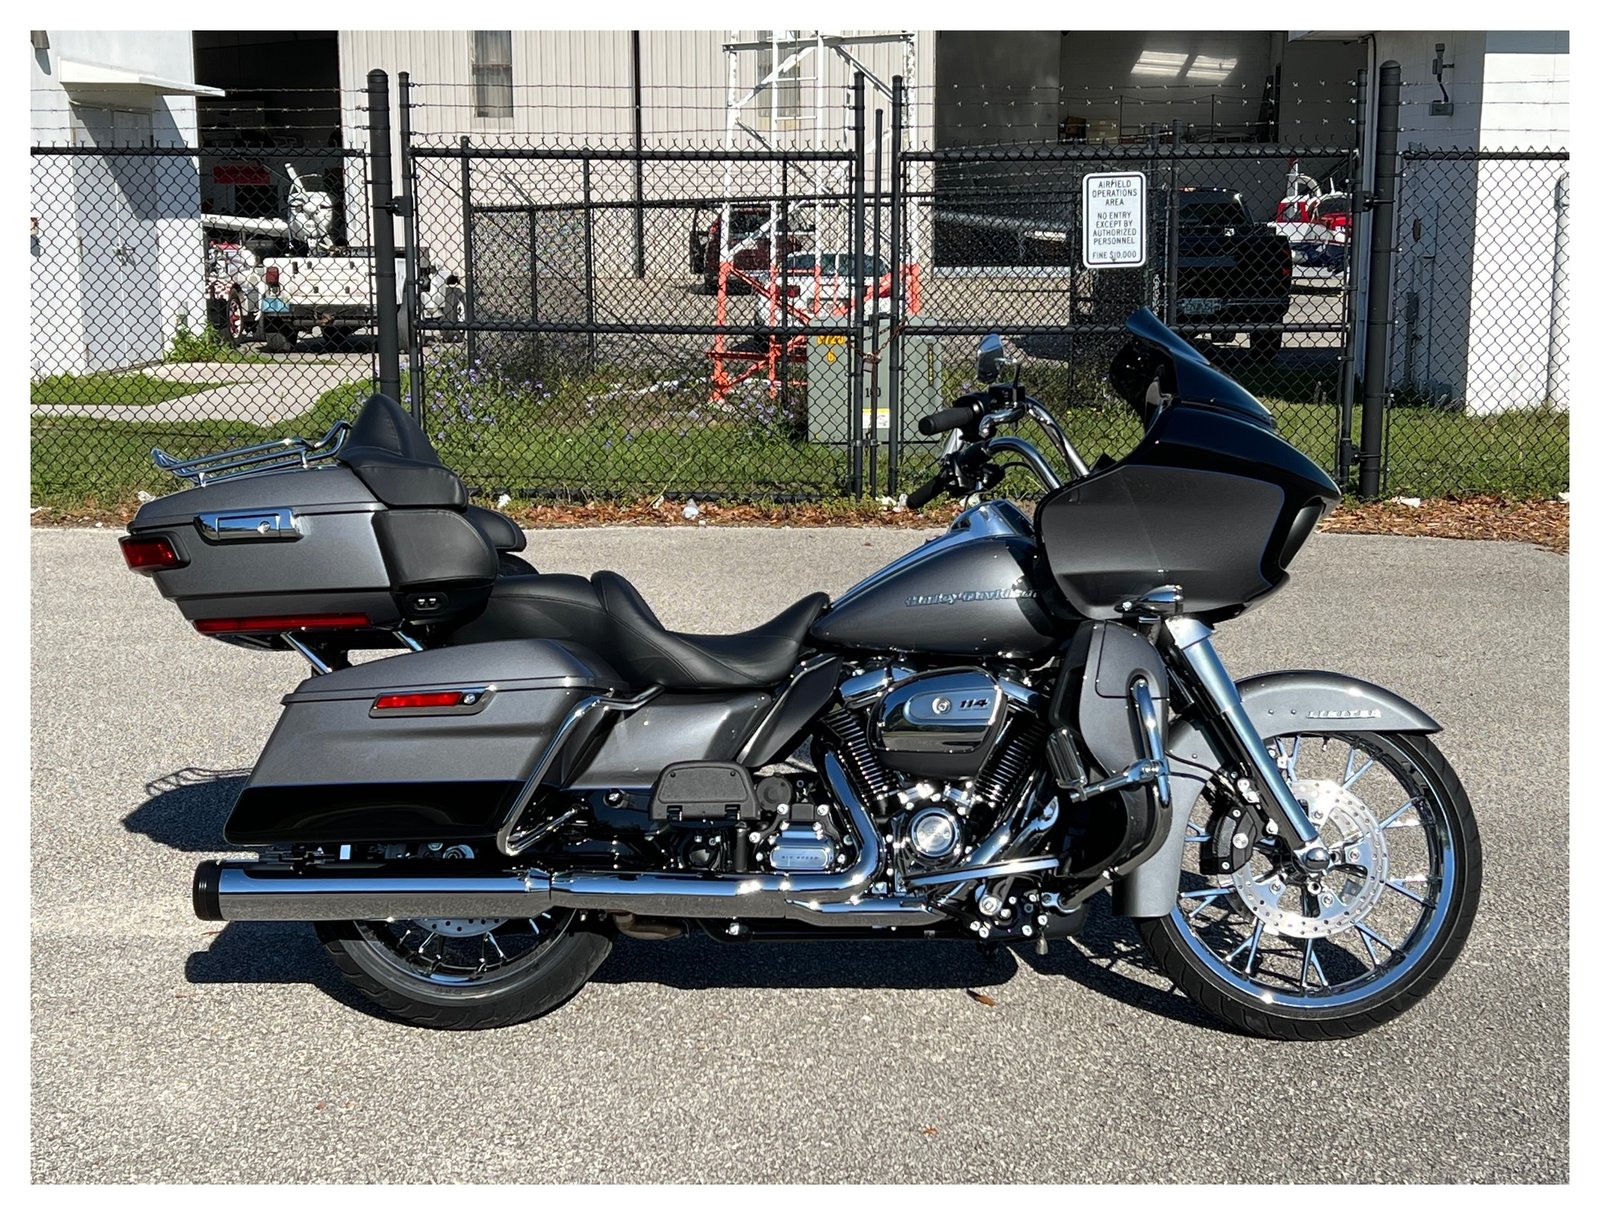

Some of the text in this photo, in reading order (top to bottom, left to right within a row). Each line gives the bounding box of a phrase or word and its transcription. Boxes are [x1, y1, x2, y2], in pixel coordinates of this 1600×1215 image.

[1098, 179, 1132, 188] AIRFIELD
[1091, 188, 1138, 198] OPERATIONS
[1105, 198, 1124, 206] AREA
[1097, 211, 1131, 220] NO ENTRY
[1096, 220, 1121, 228] EXCEPT
[1092, 228, 1137, 237] AUTHORIZED
[1093, 237, 1135, 245] PERSONNEL
[1092, 251, 1107, 259] FINE
[959, 698, 989, 708] 114
